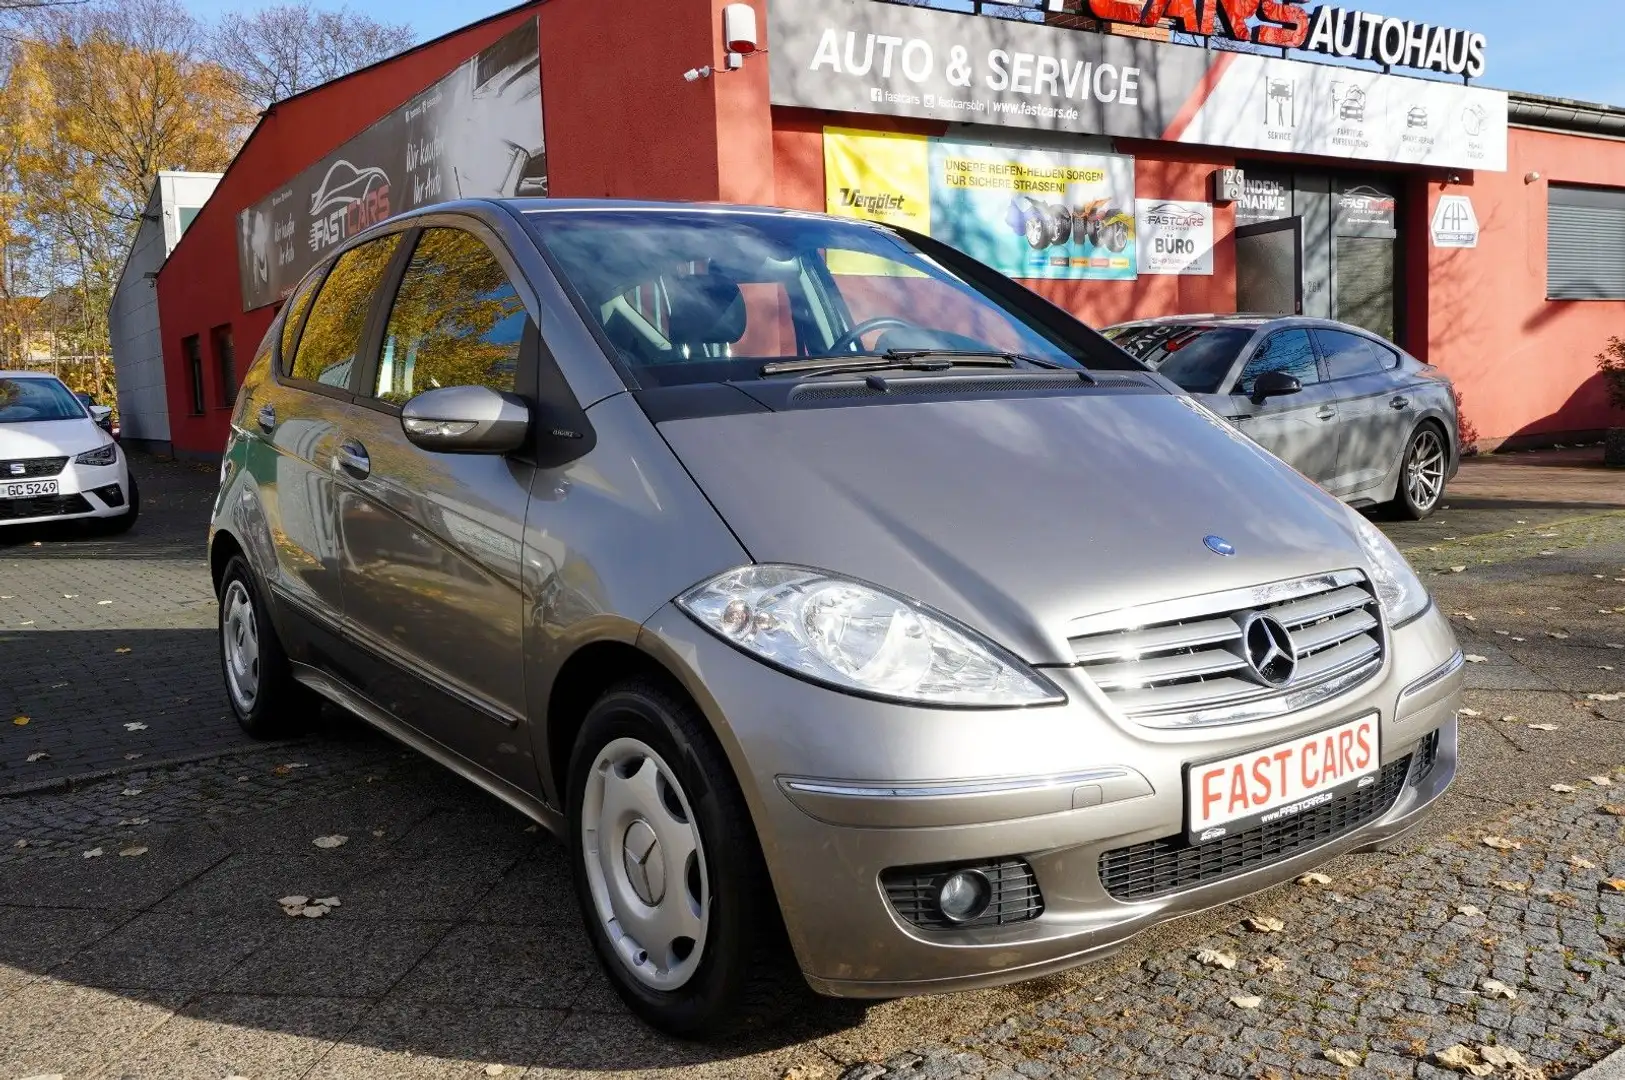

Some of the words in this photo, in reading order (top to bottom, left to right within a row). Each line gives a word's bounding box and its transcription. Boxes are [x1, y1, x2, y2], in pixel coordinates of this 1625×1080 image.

[1307, 4, 1487, 78] AUTOHAUS
[810, 28, 934, 84] AUTO
[945, 44, 974, 88] &
[985, 48, 1142, 106] SERVICE
[992, 100, 1079, 121] www.fastcars.de
[1267, 130, 1292, 141] SERVICE
[945, 159, 987, 173] UNSERE
[988, 164, 1064, 180] REIFEN-HELDEN
[1065, 169, 1104, 182] SORGEN
[1225, 168, 1243, 185] 26
[968, 176, 1011, 189] SICHERE
[1013, 179, 1066, 193] STRASSEN!
[1244, 179, 1284, 196] NDEN-
[839, 187, 905, 214] Vergölst
[308, 184, 391, 252] FASTCARS
[1147, 215, 1204, 227] FASTCARS
[1155, 233, 1195, 254] BÜRO
[8, 485, 24, 496] GC
[26, 482, 56, 495] 5249
[1202, 748, 1293, 821] FAST
[1300, 723, 1371, 789] CARS
